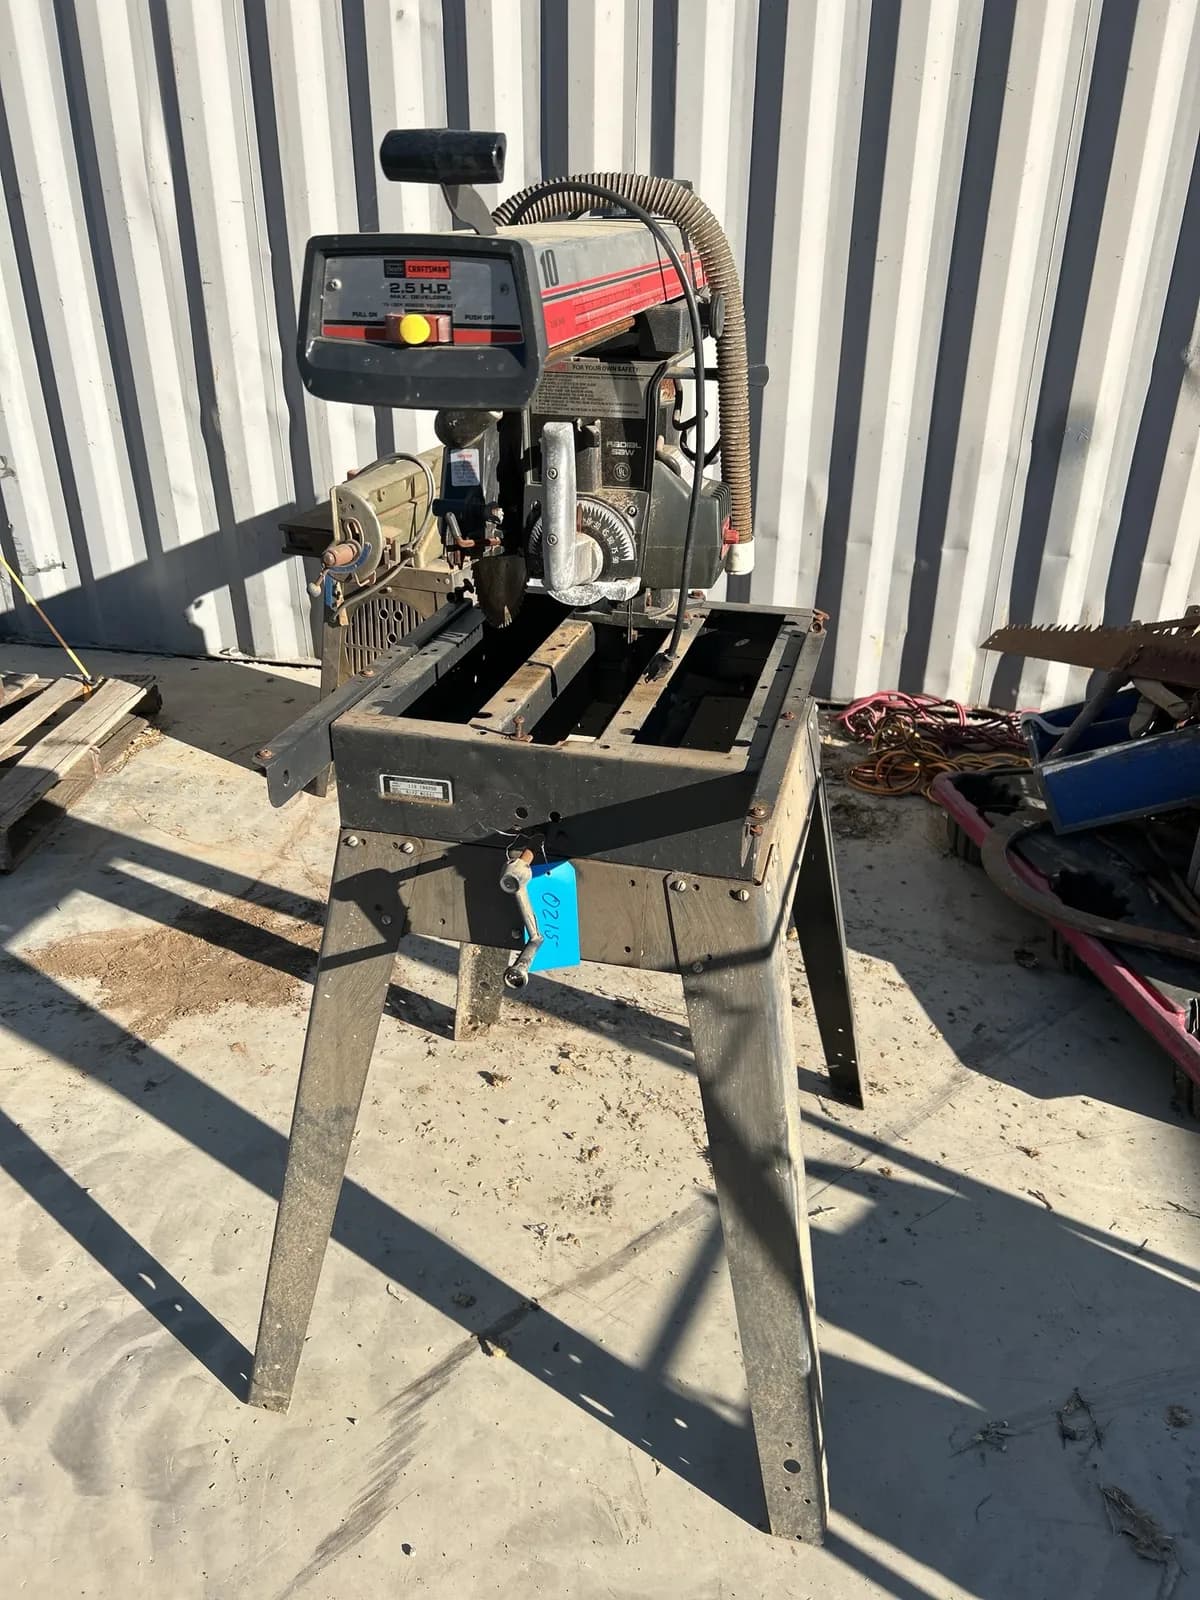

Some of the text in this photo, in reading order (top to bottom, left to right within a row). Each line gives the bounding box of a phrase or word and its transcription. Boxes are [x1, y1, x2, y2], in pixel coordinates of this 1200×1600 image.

[408, 264, 449, 274] CRAFTSMAN
[540, 249, 559, 288] 10
[389, 283, 452, 295] 2.5 H.P.
[572, 363, 585, 371] FOR
[585, 364, 602, 372] YOUR
[602, 364, 617, 372] OWN
[617, 365, 639, 373] SAFETY
[541, 892, 560, 948] 0215
